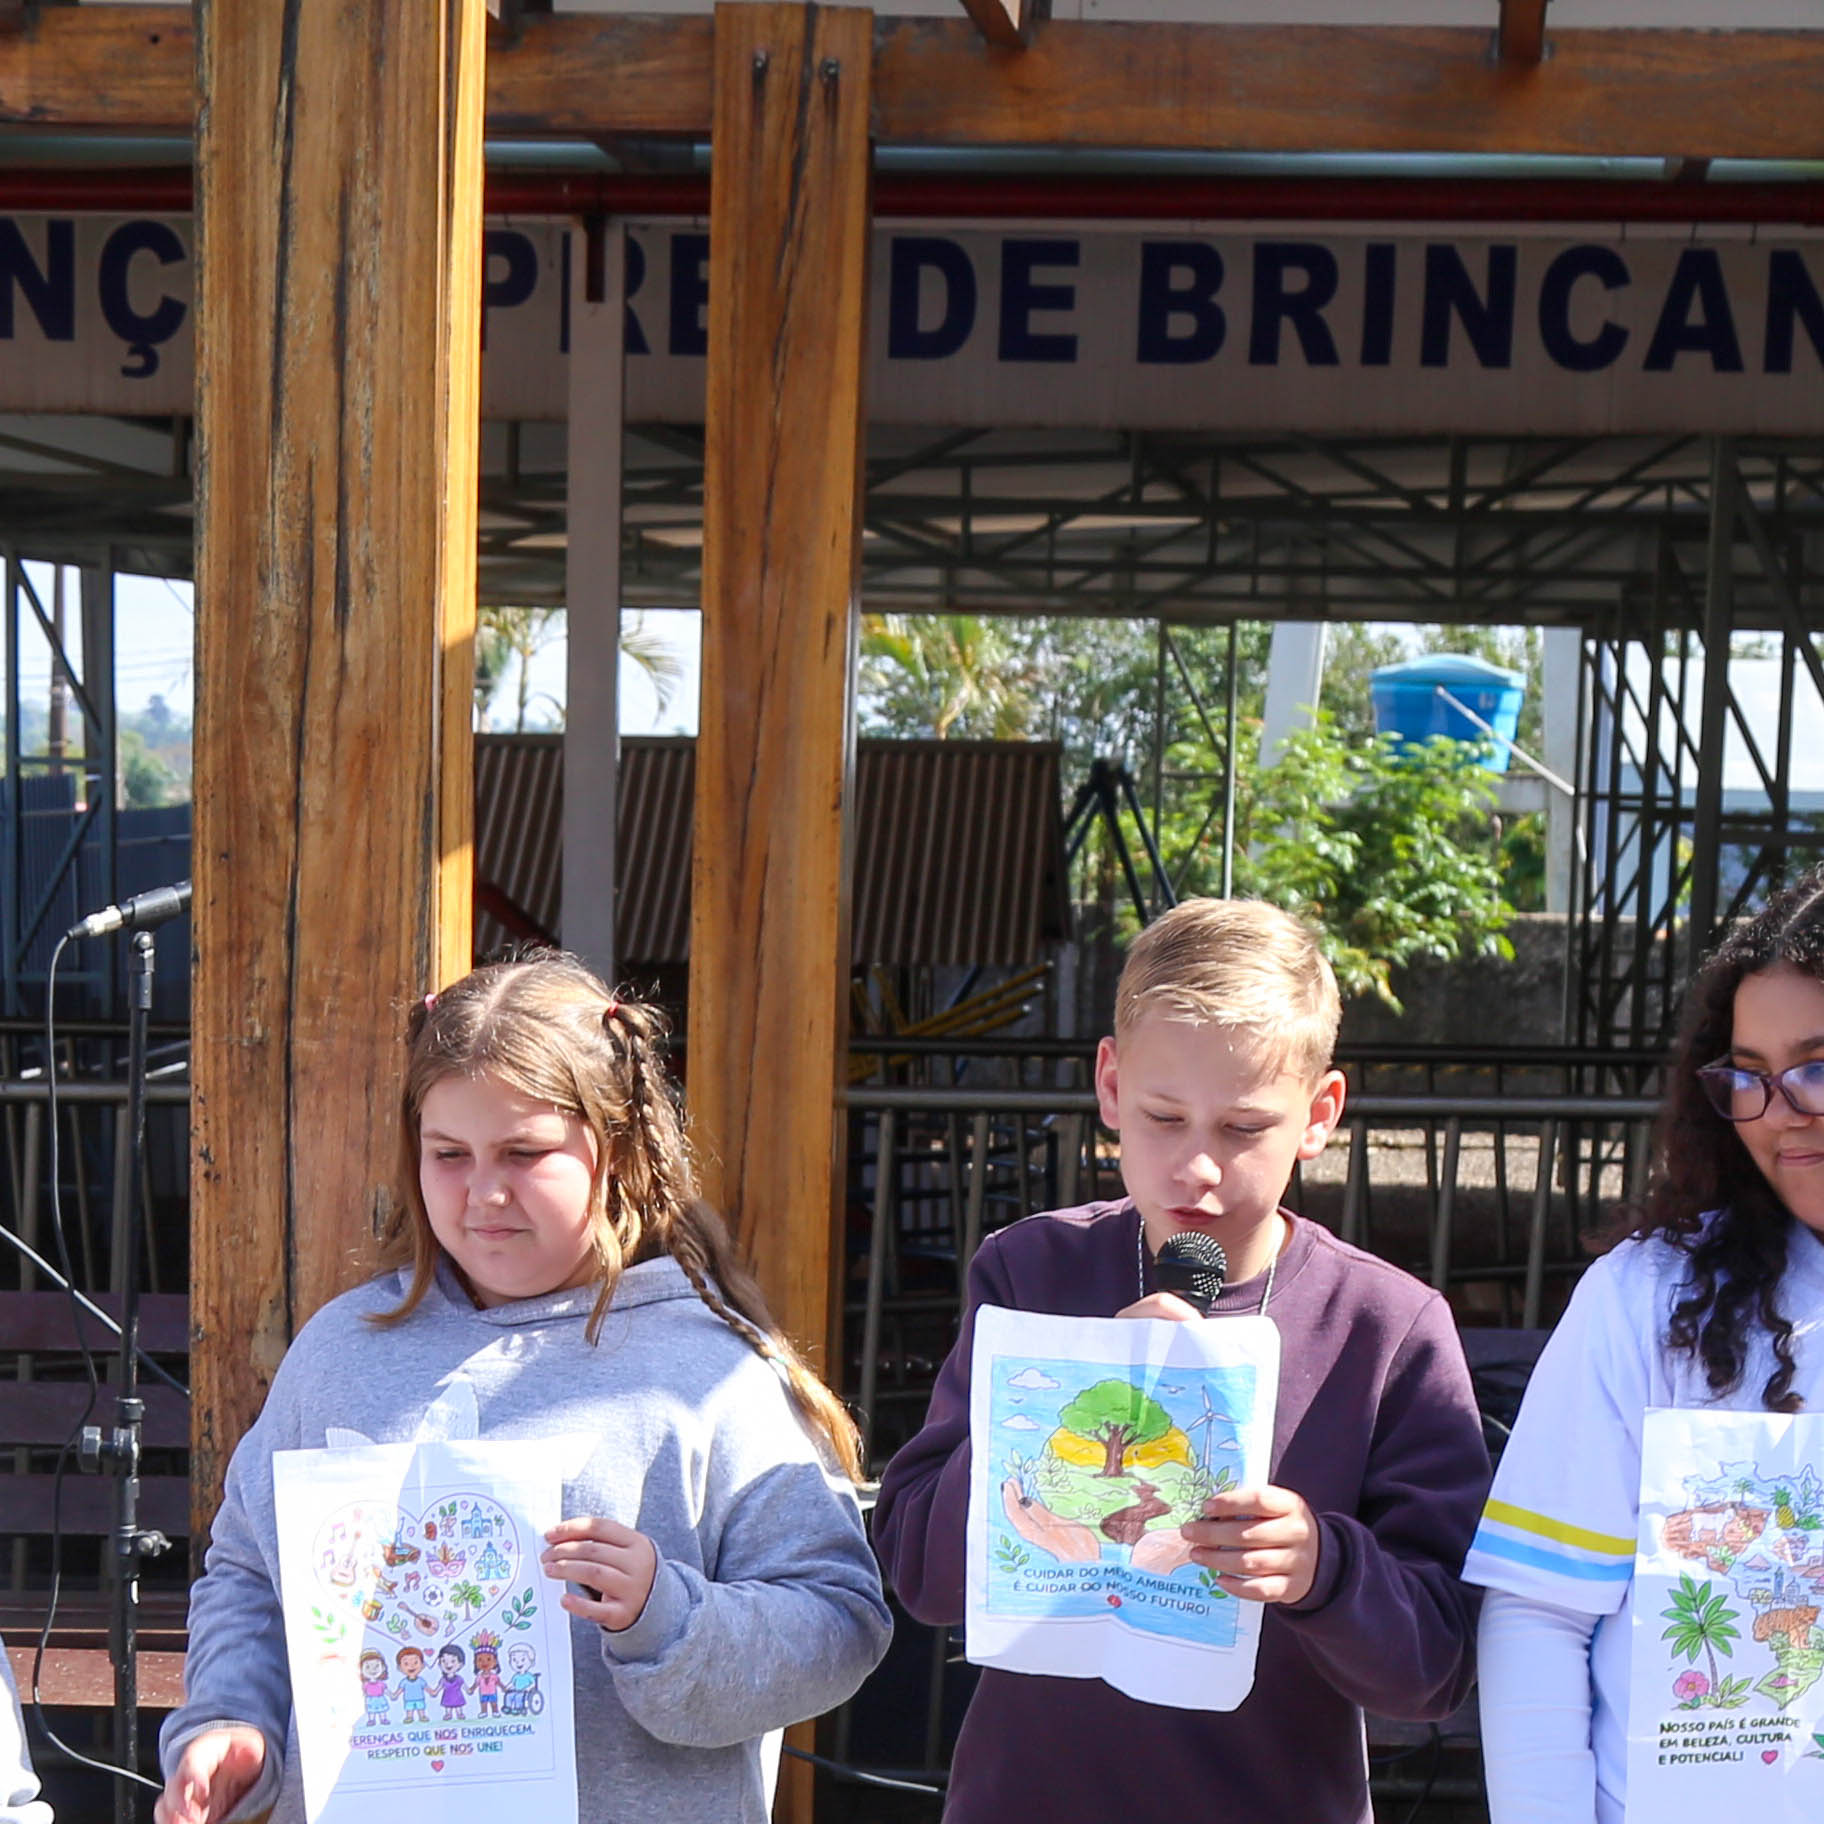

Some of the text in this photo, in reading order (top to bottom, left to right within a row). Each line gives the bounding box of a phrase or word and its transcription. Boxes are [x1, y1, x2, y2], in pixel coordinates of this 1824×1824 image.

[1023, 1566, 1204, 1599] CUIDAR DO MEIO AMBIENTE
[1013, 1581, 1210, 1616] É CUIDAR DO NOSSO FUTURO!
[1659, 1716, 1801, 1734] NOSSO PAÍS É GRANDE
[407, 1731, 432, 1743] QUE
[434, 1728, 458, 1740] NOS
[1659, 1732, 1792, 1749] EM BELEZA, CULTURA
[367, 1741, 503, 1760] RESPEITO QUE NOS UNE!
[1658, 1751, 1744, 1765] E POTENCIAL!
